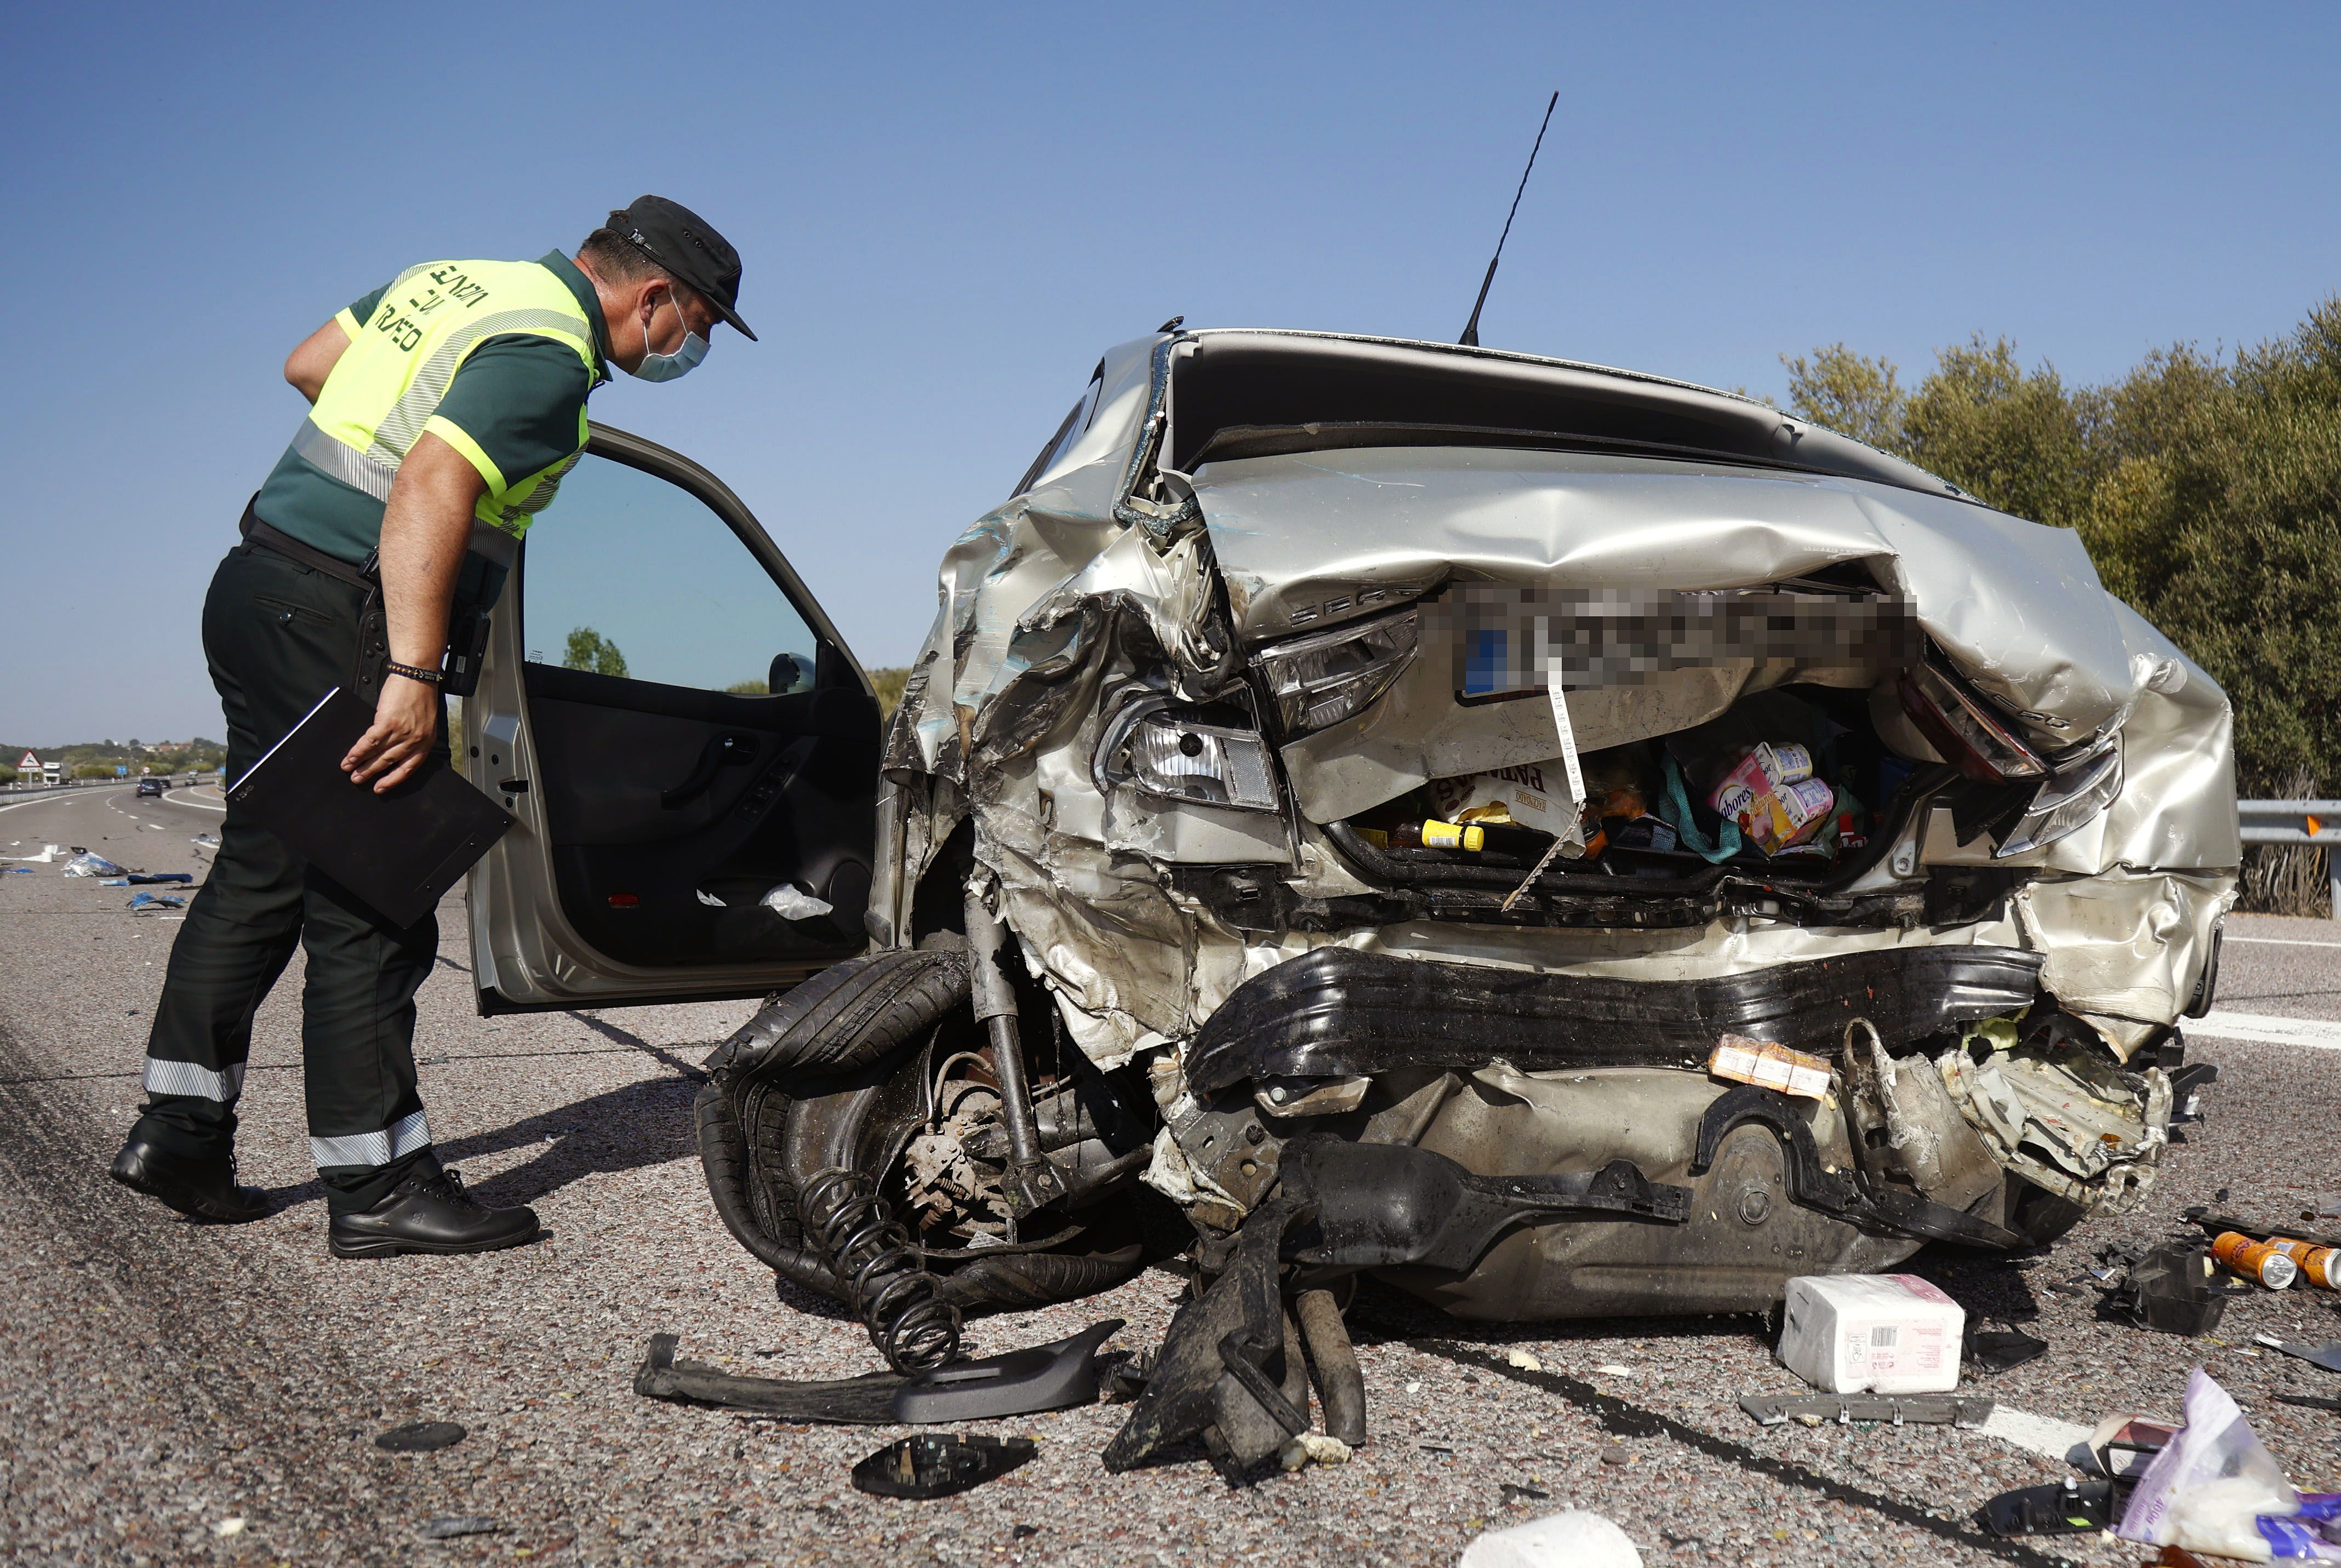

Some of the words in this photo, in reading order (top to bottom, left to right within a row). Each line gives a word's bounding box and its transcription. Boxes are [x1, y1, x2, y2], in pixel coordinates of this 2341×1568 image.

[1516, 791, 1547, 811] HACENDADO
[1720, 786, 1751, 818] abores
[2146, 1497, 2163, 1525] 400g
